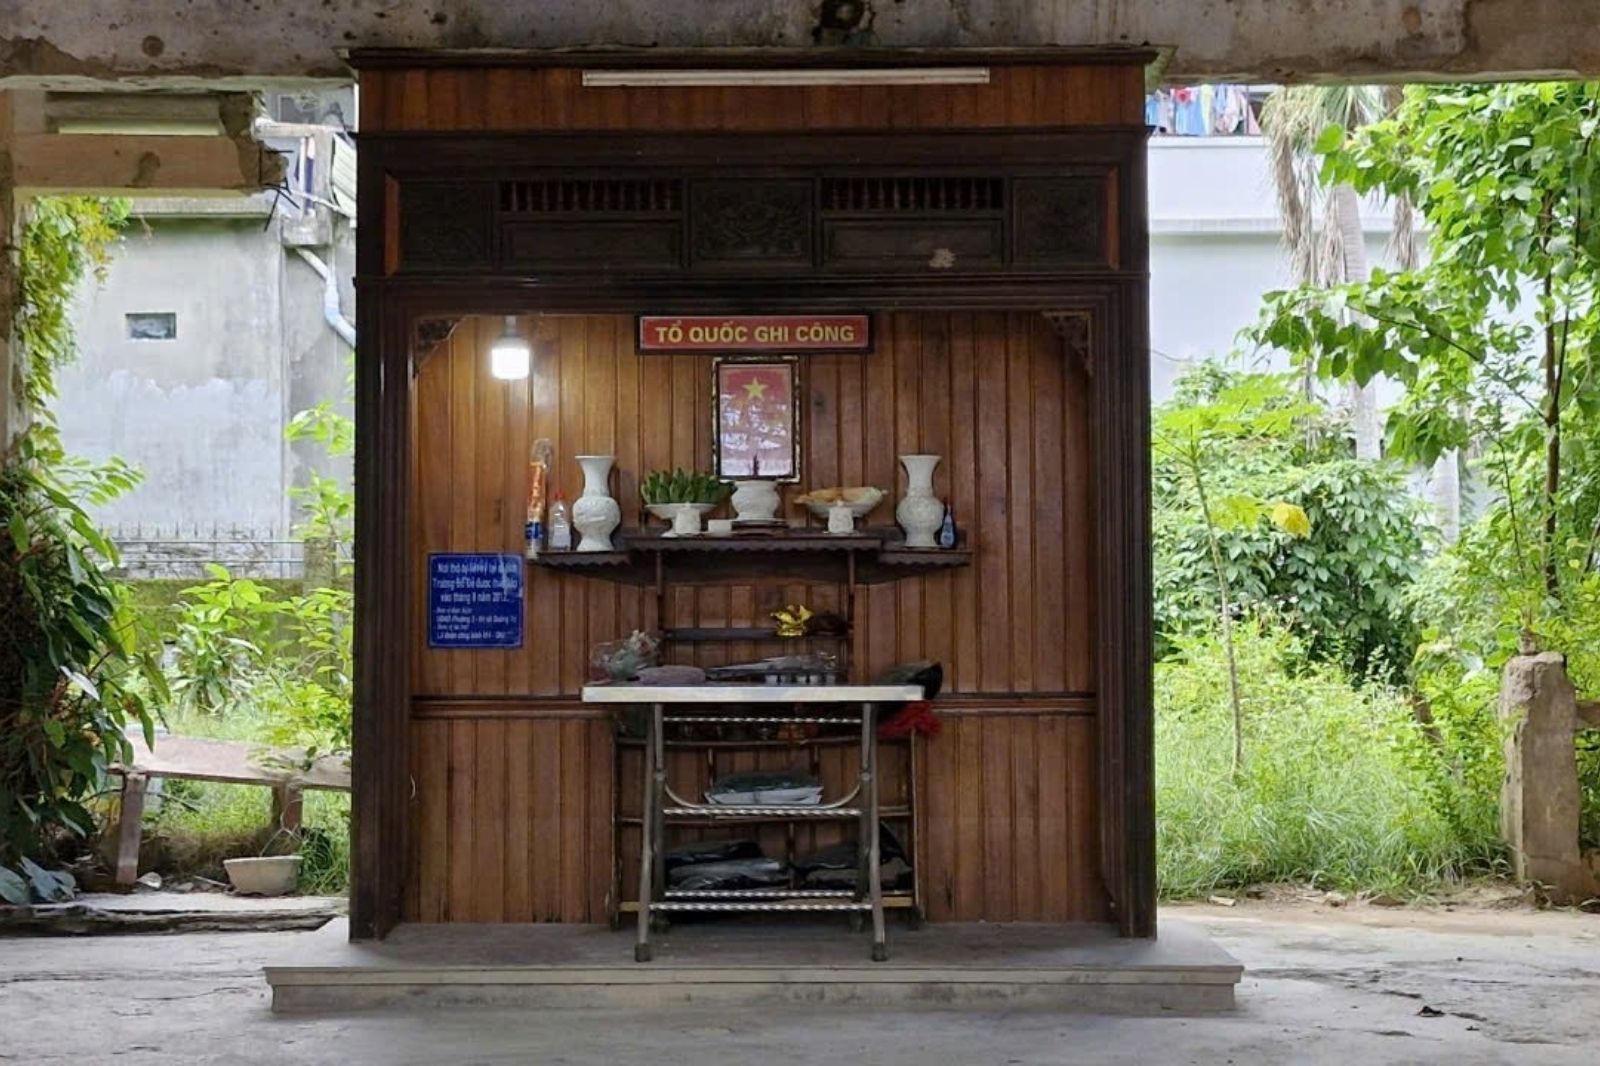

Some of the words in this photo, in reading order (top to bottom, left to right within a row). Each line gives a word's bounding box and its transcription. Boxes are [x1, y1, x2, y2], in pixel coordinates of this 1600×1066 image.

[655, 320, 683, 343] TỔ
[689, 320, 748, 343] QUỐC
[754, 326, 788, 342] GHI
[795, 321, 855, 342] CÔNG
